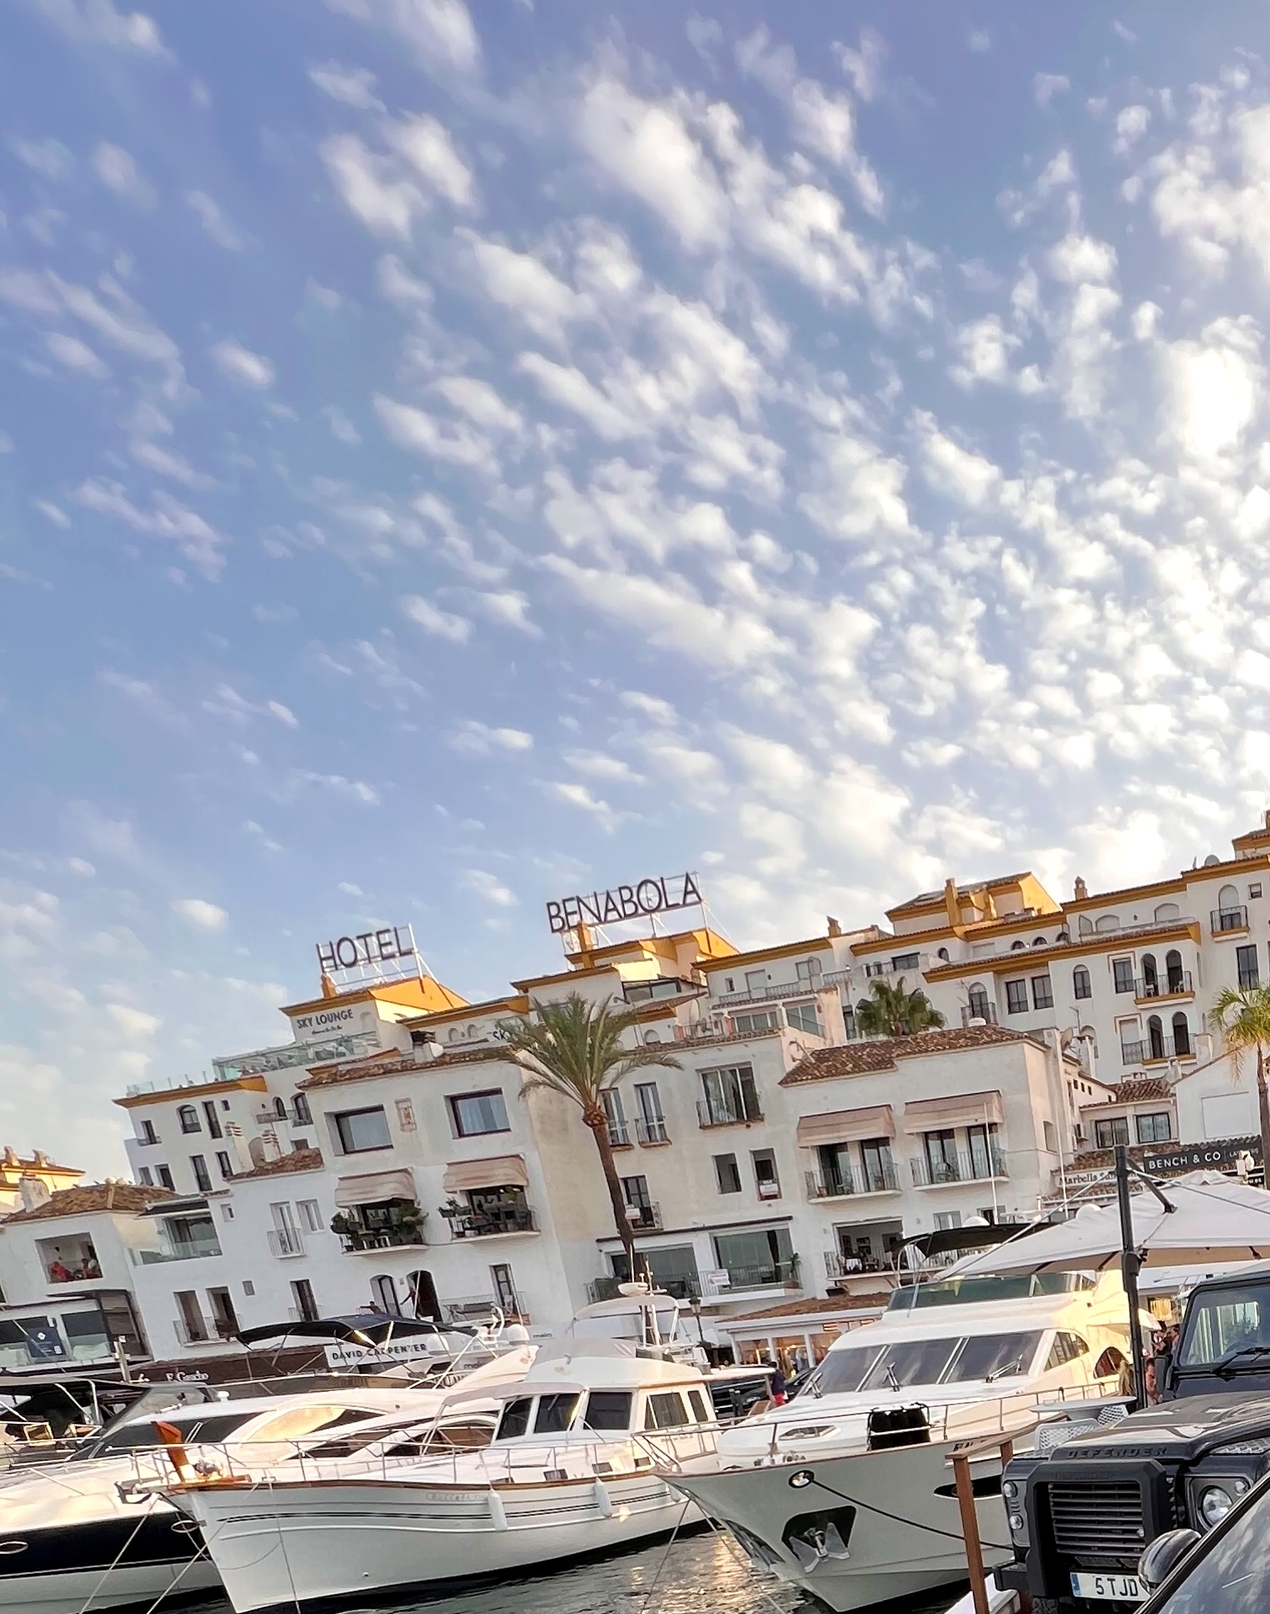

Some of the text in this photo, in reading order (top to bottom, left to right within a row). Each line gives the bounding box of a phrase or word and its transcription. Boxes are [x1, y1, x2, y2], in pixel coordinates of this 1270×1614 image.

[546, 871, 702, 933] BENABOLA
[316, 926, 414, 973] HOTEL
[297, 1009, 353, 1029] SKY LOUNGE
[1149, 1157, 1188, 1170] BENCH
[1192, 1153, 1200, 1164] &
[1204, 1151, 1221, 1162] CO
[332, 1350, 363, 1361] DAVID
[1066, 1447, 1168, 1460] DEFENDER
